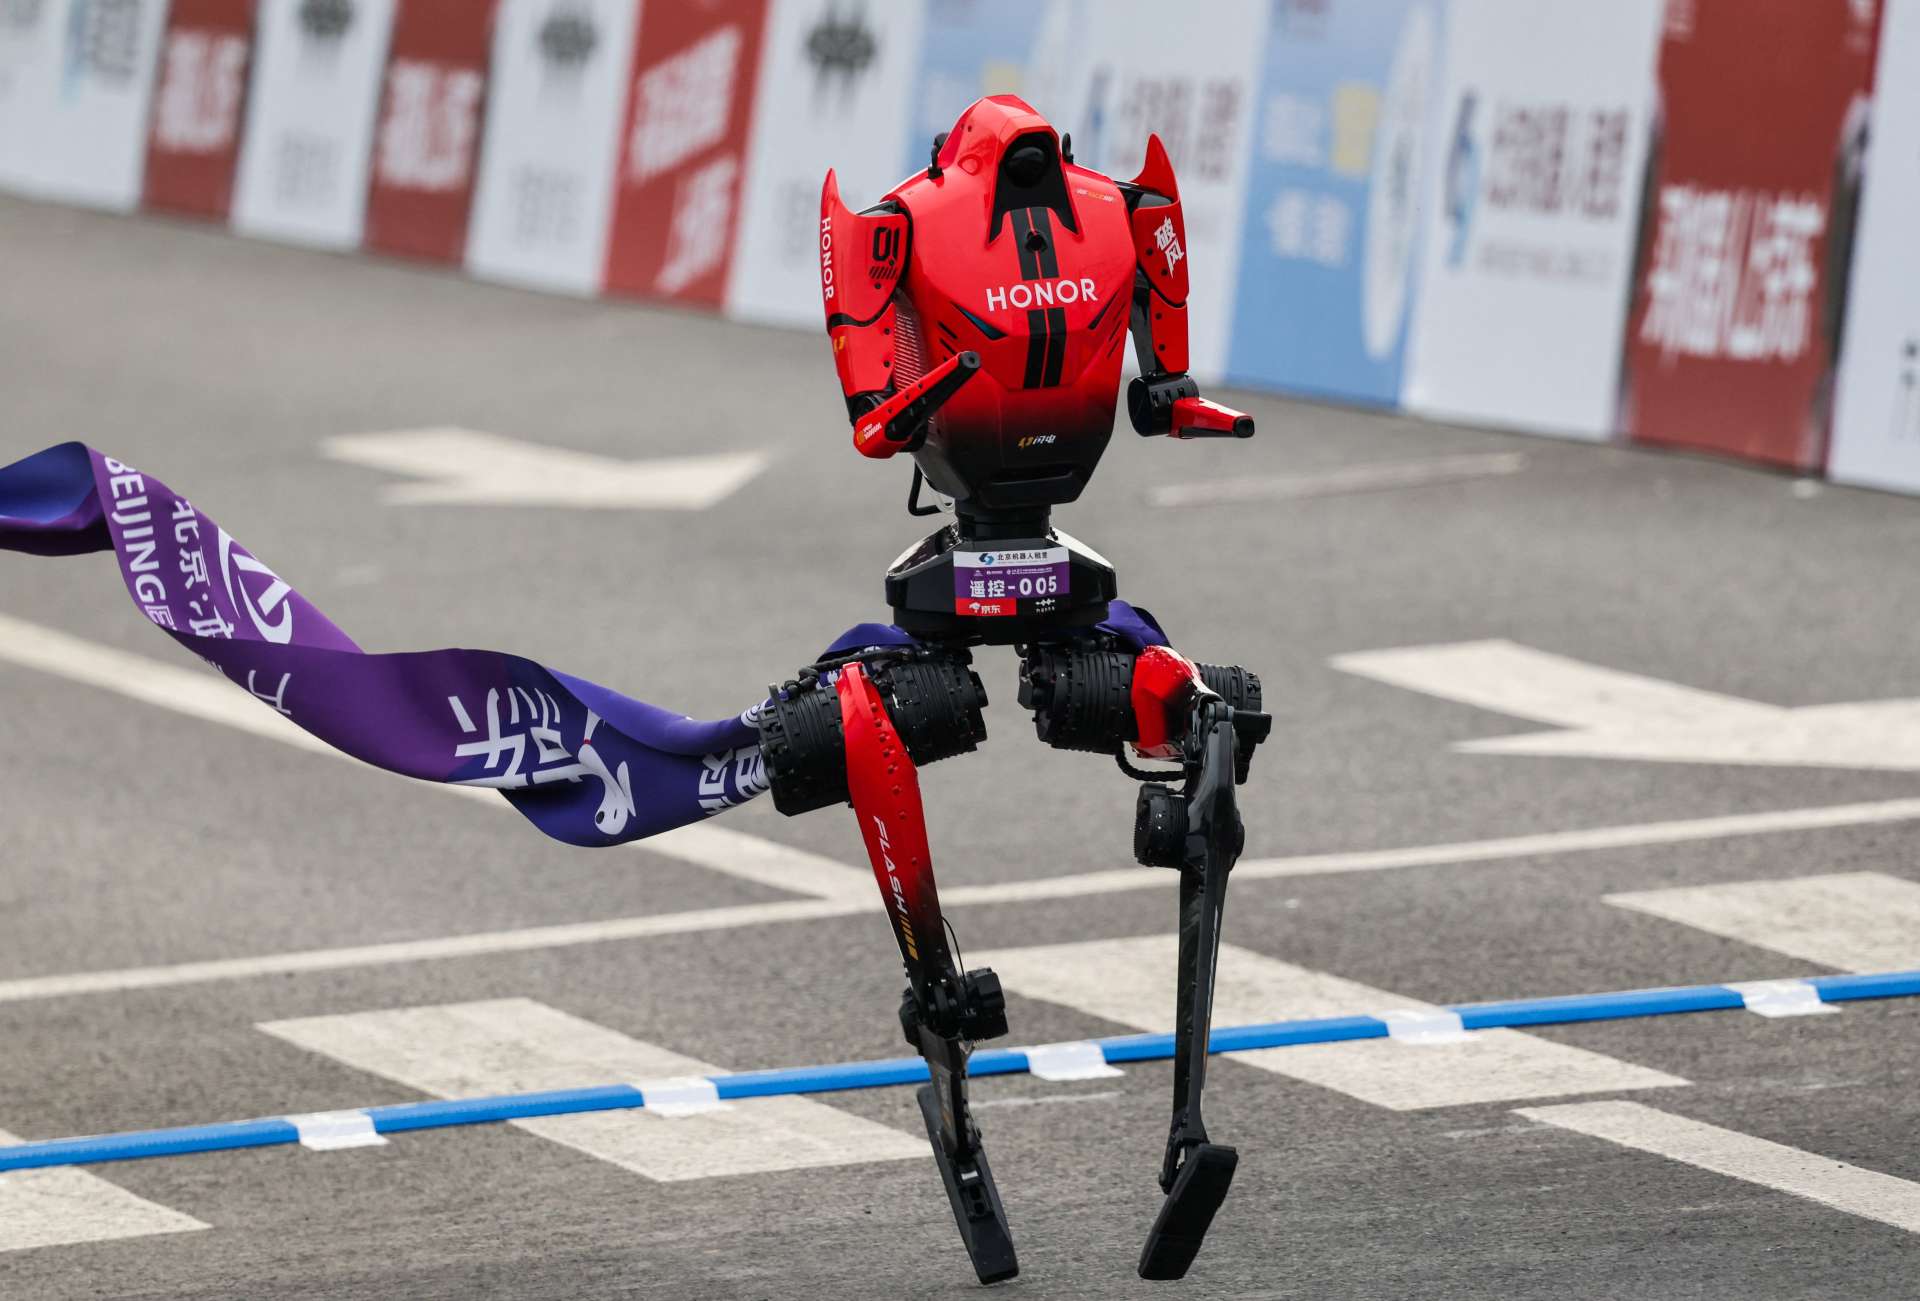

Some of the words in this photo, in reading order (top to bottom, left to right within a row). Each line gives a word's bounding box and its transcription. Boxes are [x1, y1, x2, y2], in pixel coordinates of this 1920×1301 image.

[821, 217, 834, 301] HONOR
[1154, 216, 1184, 278] 破风
[986, 278, 1098, 312] HONOR
[981, 604, 1000, 615] 京东
[873, 815, 908, 914] FLASH
